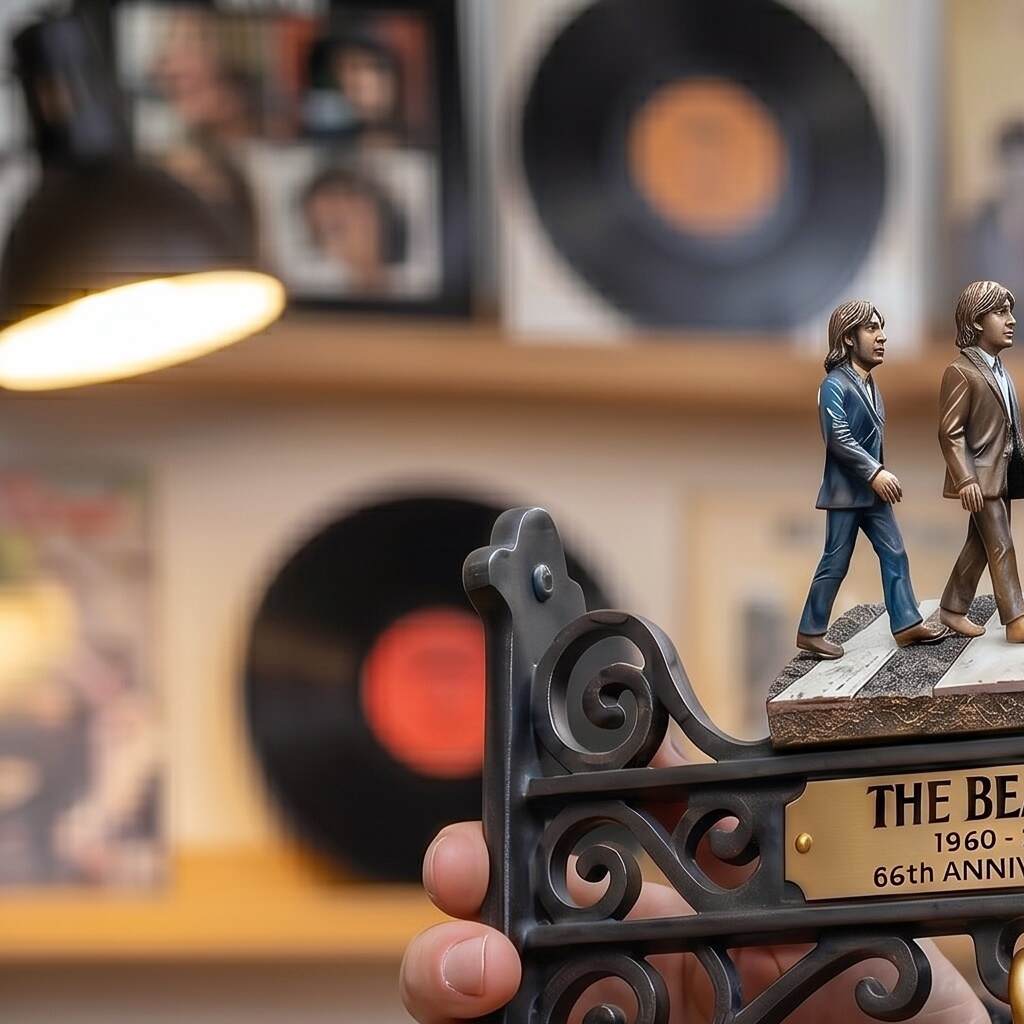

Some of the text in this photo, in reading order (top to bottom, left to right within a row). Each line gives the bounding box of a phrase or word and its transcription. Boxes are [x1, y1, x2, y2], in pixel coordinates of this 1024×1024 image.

[866, 780, 952, 829] THE
[934, 828, 997, 853] 1960
[872, 862, 935, 888] 66th
